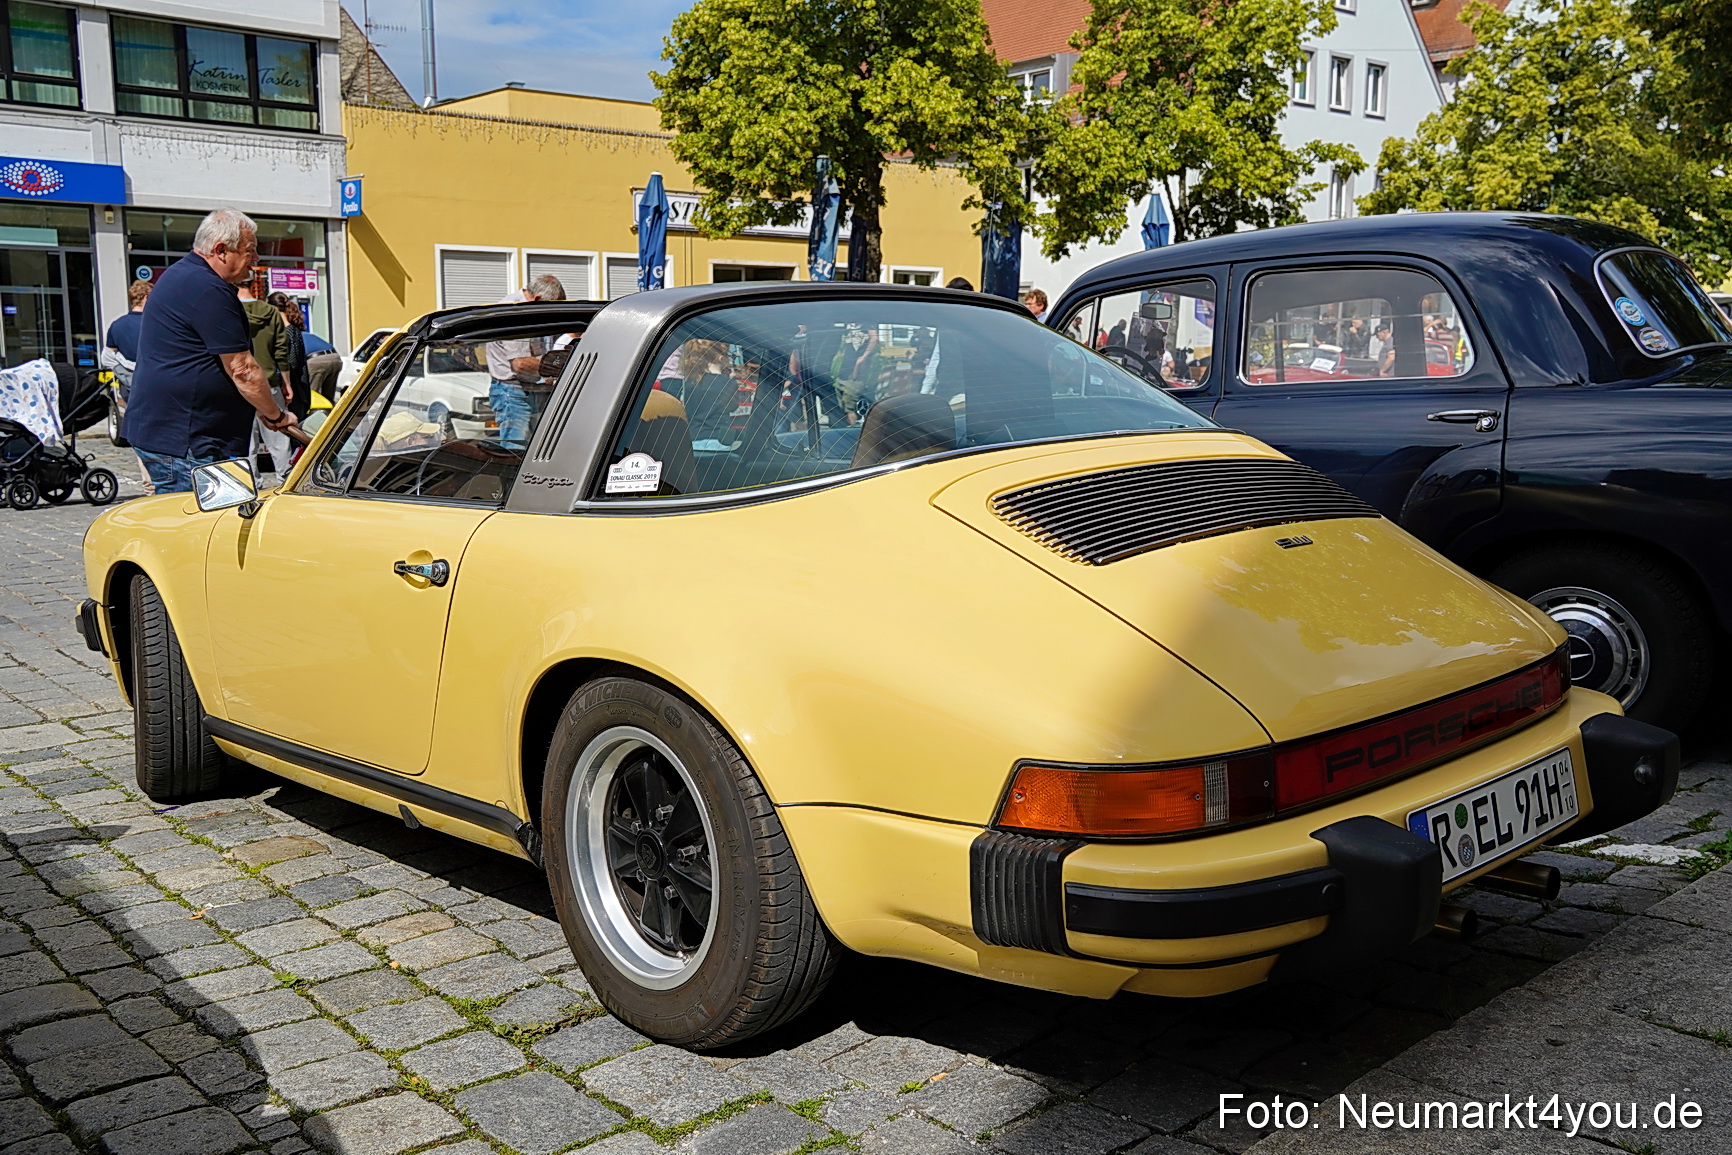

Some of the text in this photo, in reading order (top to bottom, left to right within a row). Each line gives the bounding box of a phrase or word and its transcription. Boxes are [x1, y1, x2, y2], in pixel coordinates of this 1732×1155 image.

[188, 59, 301, 88] Katrin Tasler
[195, 80, 242, 93] KOSMETIK
[342, 201, 359, 215] Apollo
[610, 474, 626, 482] DONAU
[626, 473, 643, 481] CLASSIC
[584, 682, 665, 715] MICHELIN
[1325, 681, 1544, 783] PORSCHE
